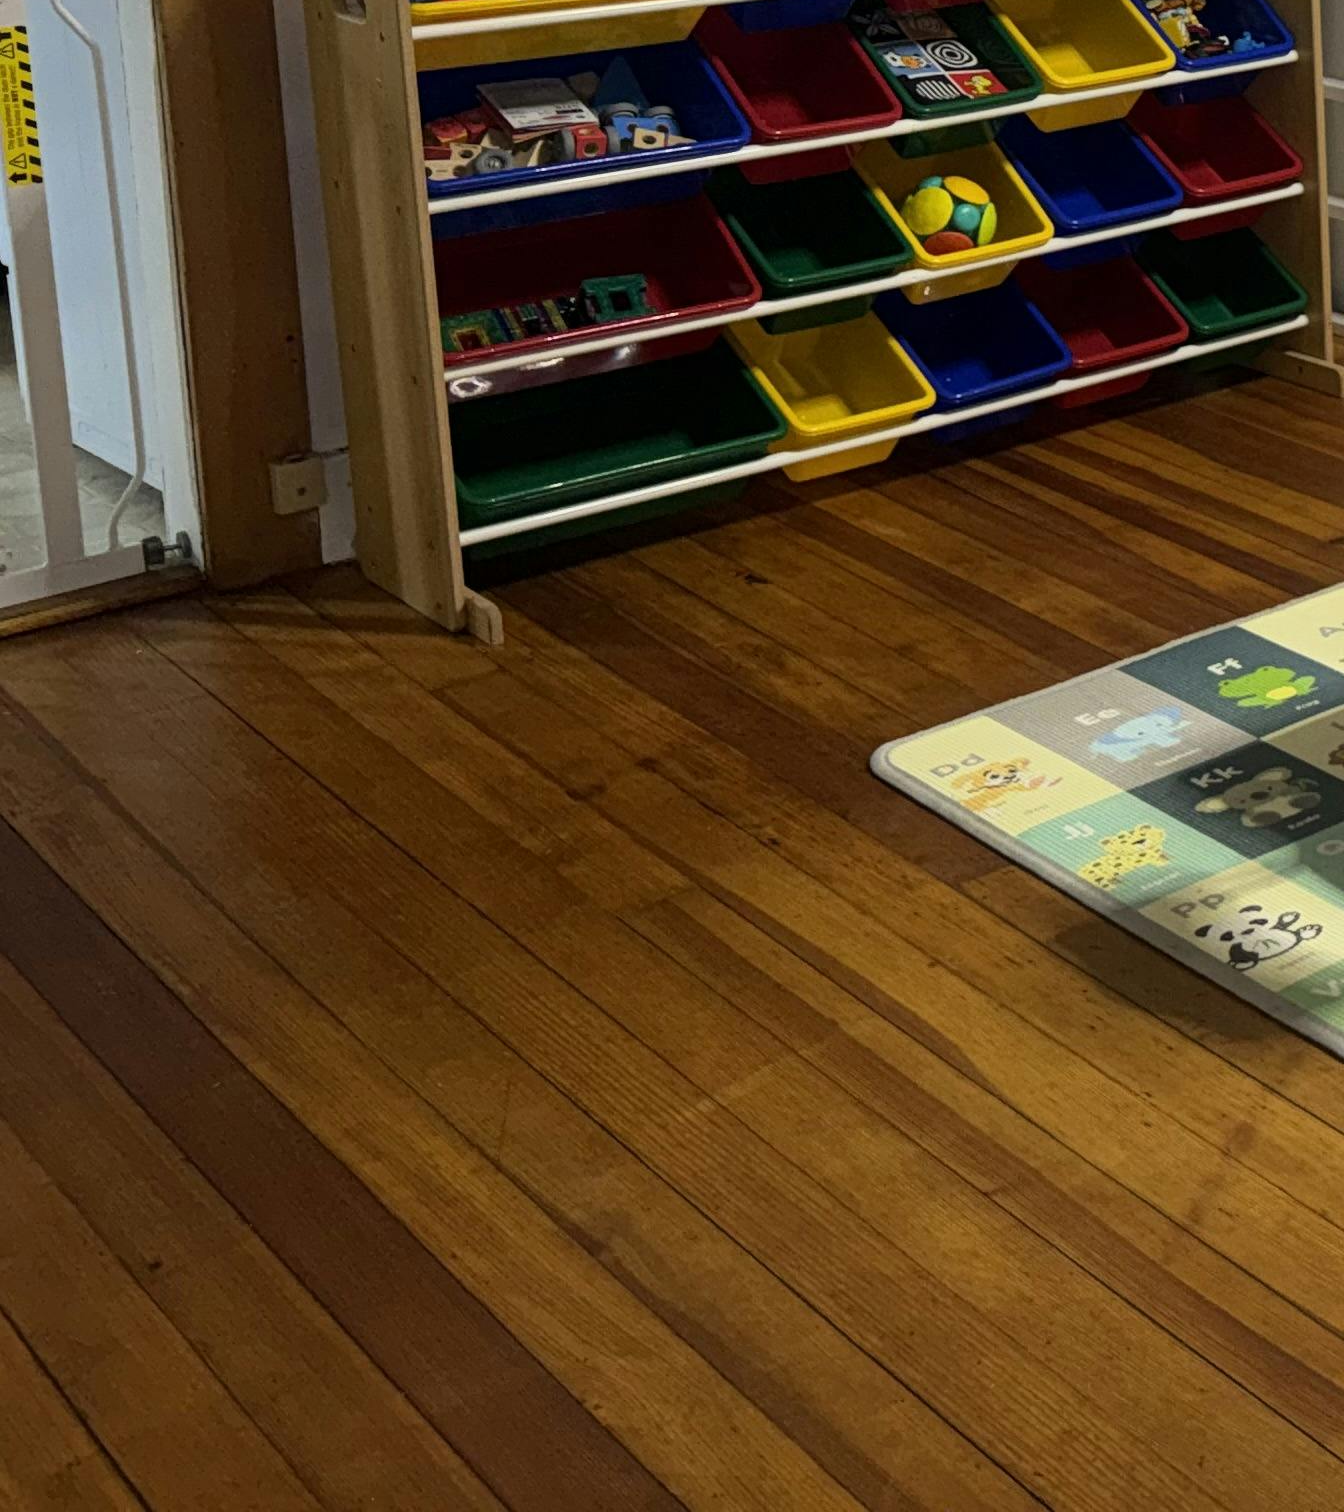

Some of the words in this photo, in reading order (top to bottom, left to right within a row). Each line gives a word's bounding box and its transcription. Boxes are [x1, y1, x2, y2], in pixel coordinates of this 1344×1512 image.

[1207, 657, 1243, 675] Ff
[1073, 708, 1121, 726] Ee
[930, 753, 985, 778] Dd
[1190, 765, 1244, 789] Kk
[1171, 893, 1225, 919] Pp
